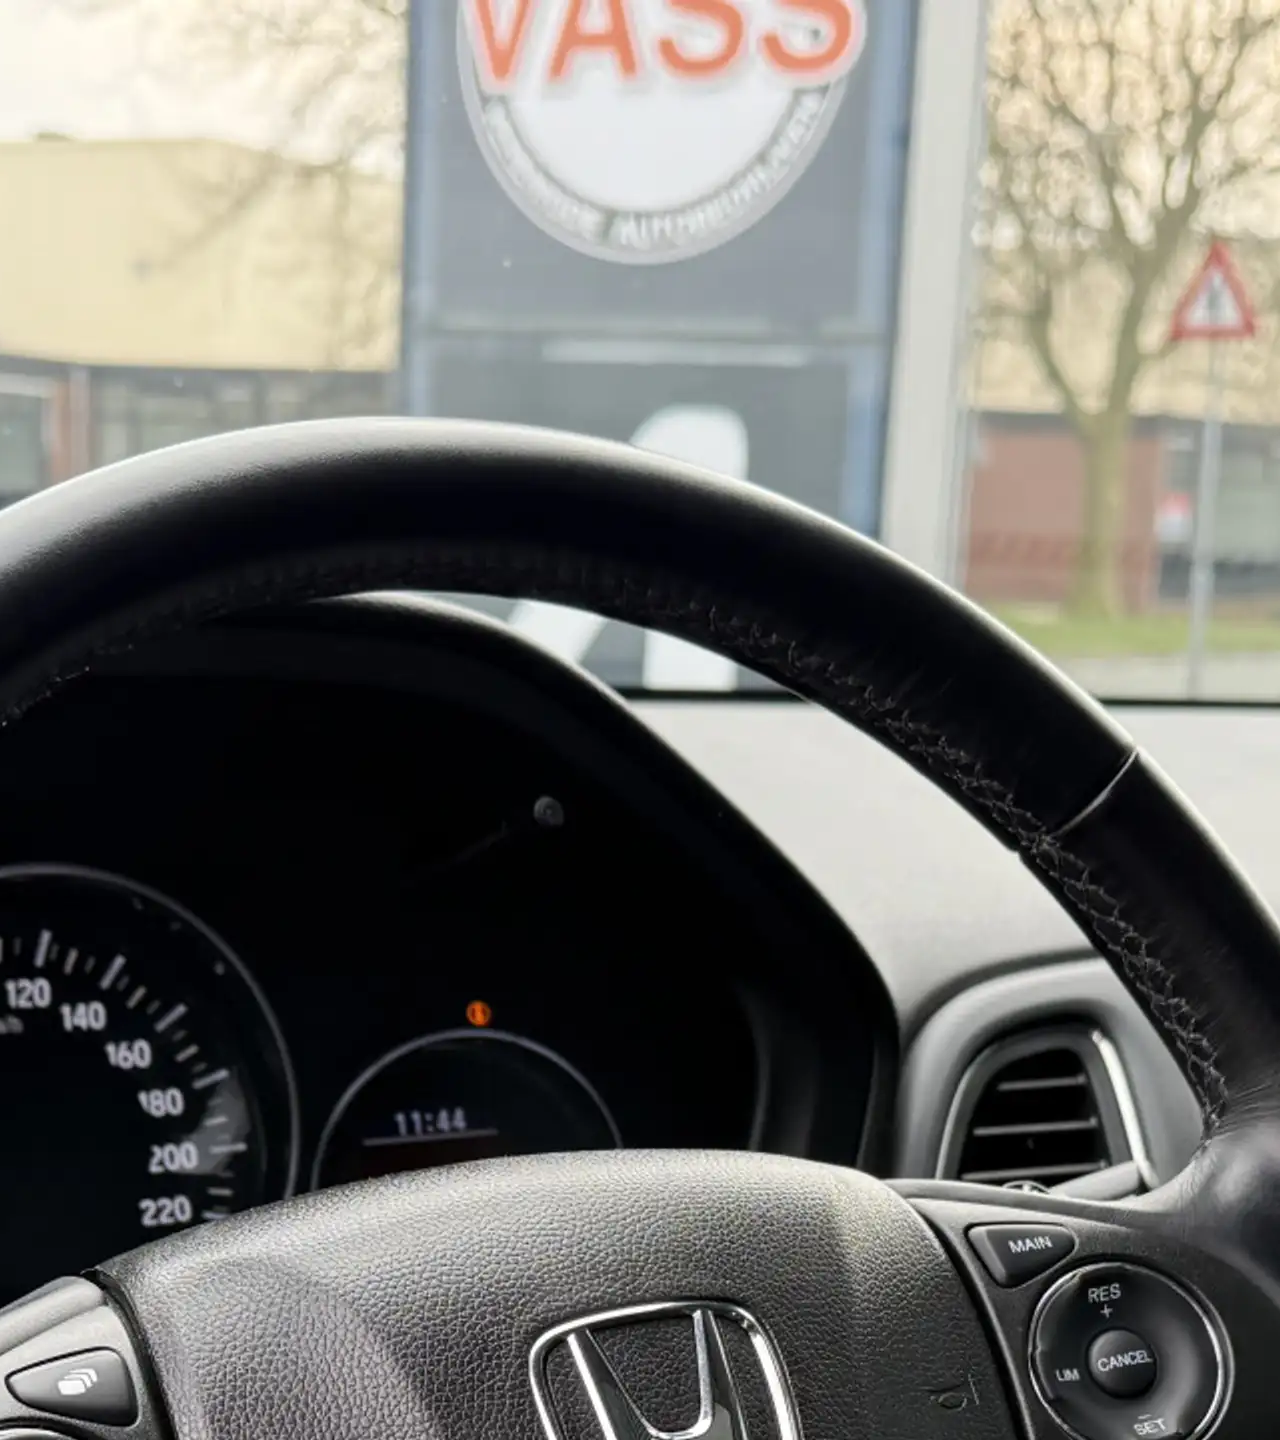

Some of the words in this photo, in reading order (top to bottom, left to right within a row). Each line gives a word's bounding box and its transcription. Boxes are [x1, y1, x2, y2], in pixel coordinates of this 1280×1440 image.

[467, 0, 856, 80] VASS
[5, 977, 51, 1008] 120
[60, 1001, 106, 1031] 140
[105, 1038, 152, 1069] 160
[138, 1088, 184, 1117] 180
[394, 1106, 467, 1136] 11:44
[148, 1141, 199, 1174] 200
[138, 1196, 192, 1227] 220
[1007, 1236, 1053, 1254] MAIN
[1088, 1283, 1122, 1303] RES
[1056, 1369, 1080, 1382] LIM
[1096, 1350, 1154, 1372] CANCEL
[1133, 1418, 1168, 1436] SET
